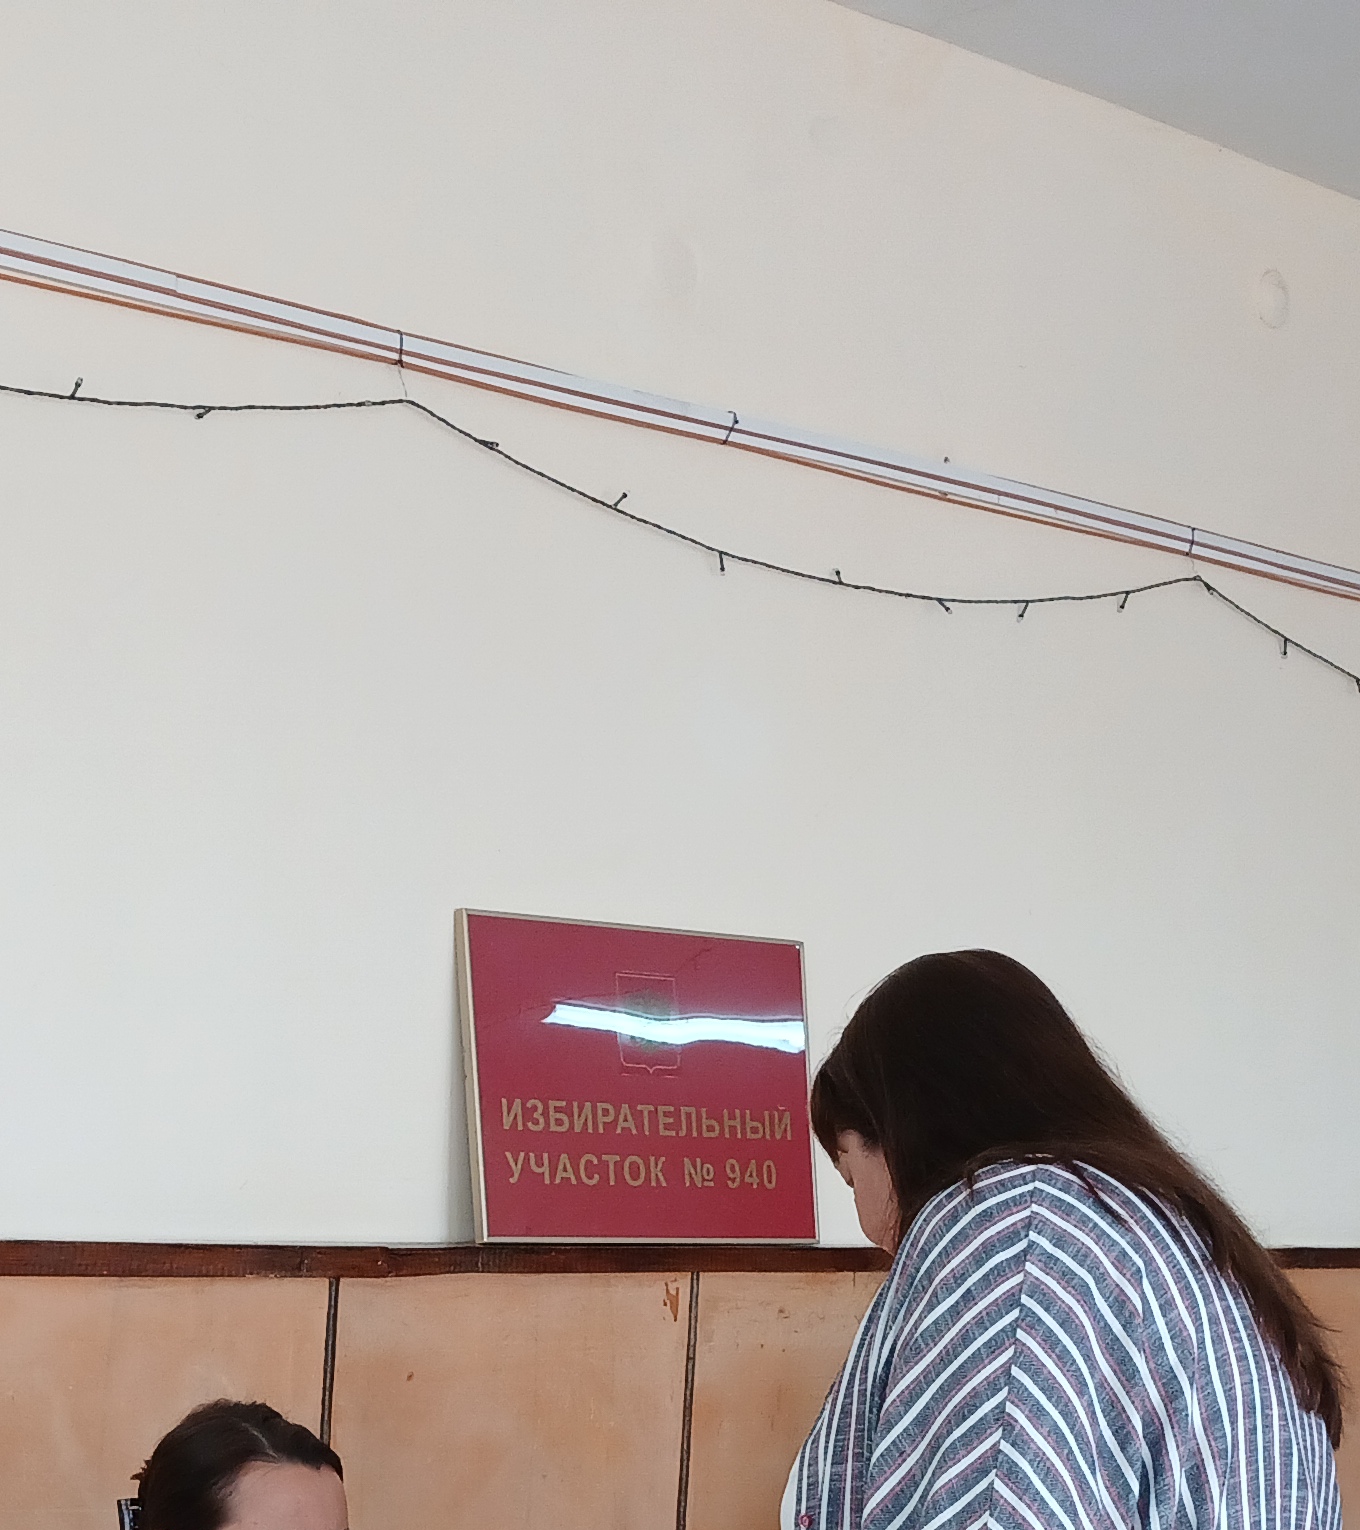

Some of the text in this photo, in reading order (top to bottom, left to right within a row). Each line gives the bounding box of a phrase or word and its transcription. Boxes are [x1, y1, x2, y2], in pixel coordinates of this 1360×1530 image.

[500, 1097, 793, 1141] ИЗБИРАТЕЛЬНЫЙ
[504, 1151, 778, 1190] УЧАСТОК № 940
